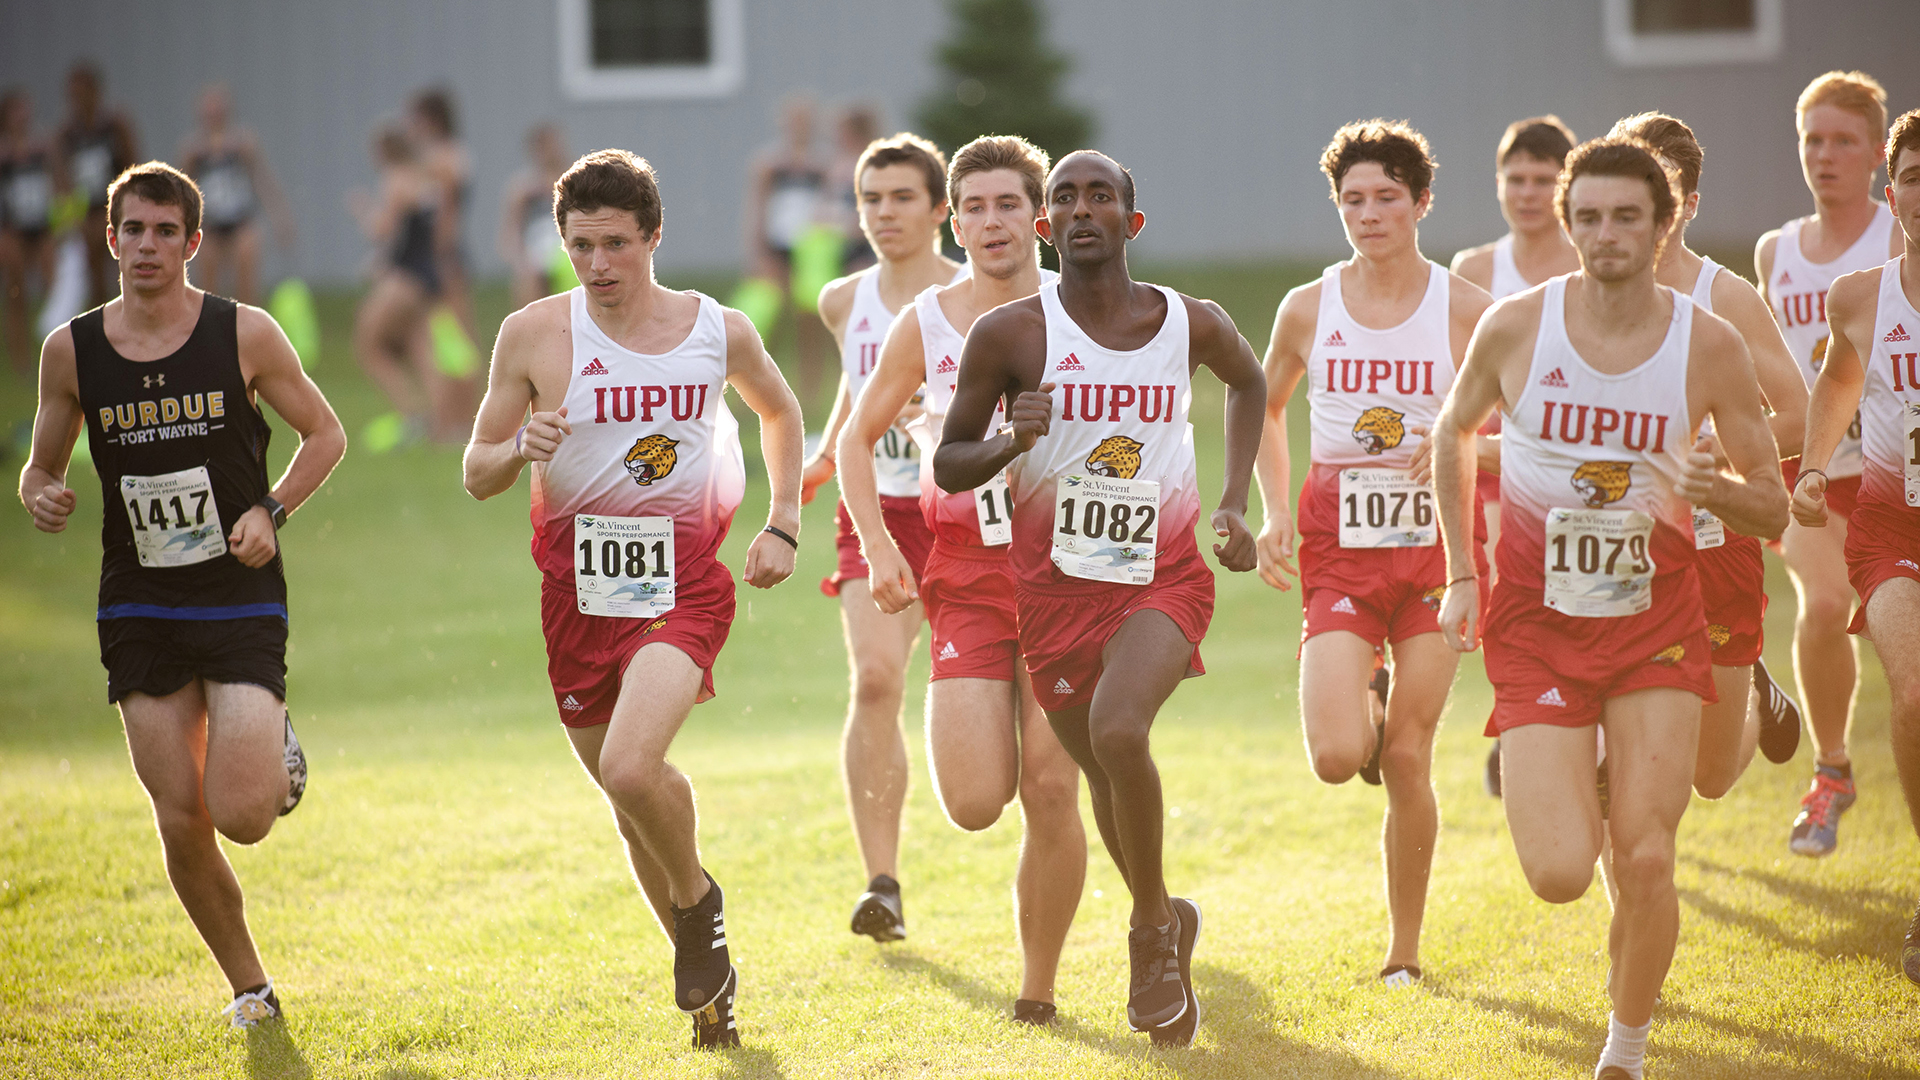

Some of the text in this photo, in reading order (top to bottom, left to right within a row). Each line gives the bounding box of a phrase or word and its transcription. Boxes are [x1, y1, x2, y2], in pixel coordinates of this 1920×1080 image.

[1883, 334, 1911, 343] adidas
[581, 367, 609, 376] adidas
[1056, 363, 1085, 372] adidas
[1326, 359, 1434, 395] IUPUI
[99, 390, 225, 433] PURDUE
[594, 384, 708, 424] IUPUI
[1062, 383, 1176, 423] IUPUI
[119, 422, 208, 446] FORT WAYNE
[1540, 401, 1668, 453] IUPUI
[162, 481, 207, 495] PERFORMANCE
[1082, 490, 1157, 503] SPORTS PERFORMANCE
[129, 490, 209, 532] 1417
[1059, 498, 1156, 544] 1082
[1345, 491, 1432, 528] 1076
[622, 531, 671, 539] PERFORMANCE
[579, 539, 670, 579] 1081
[1551, 534, 1651, 576] 1079
